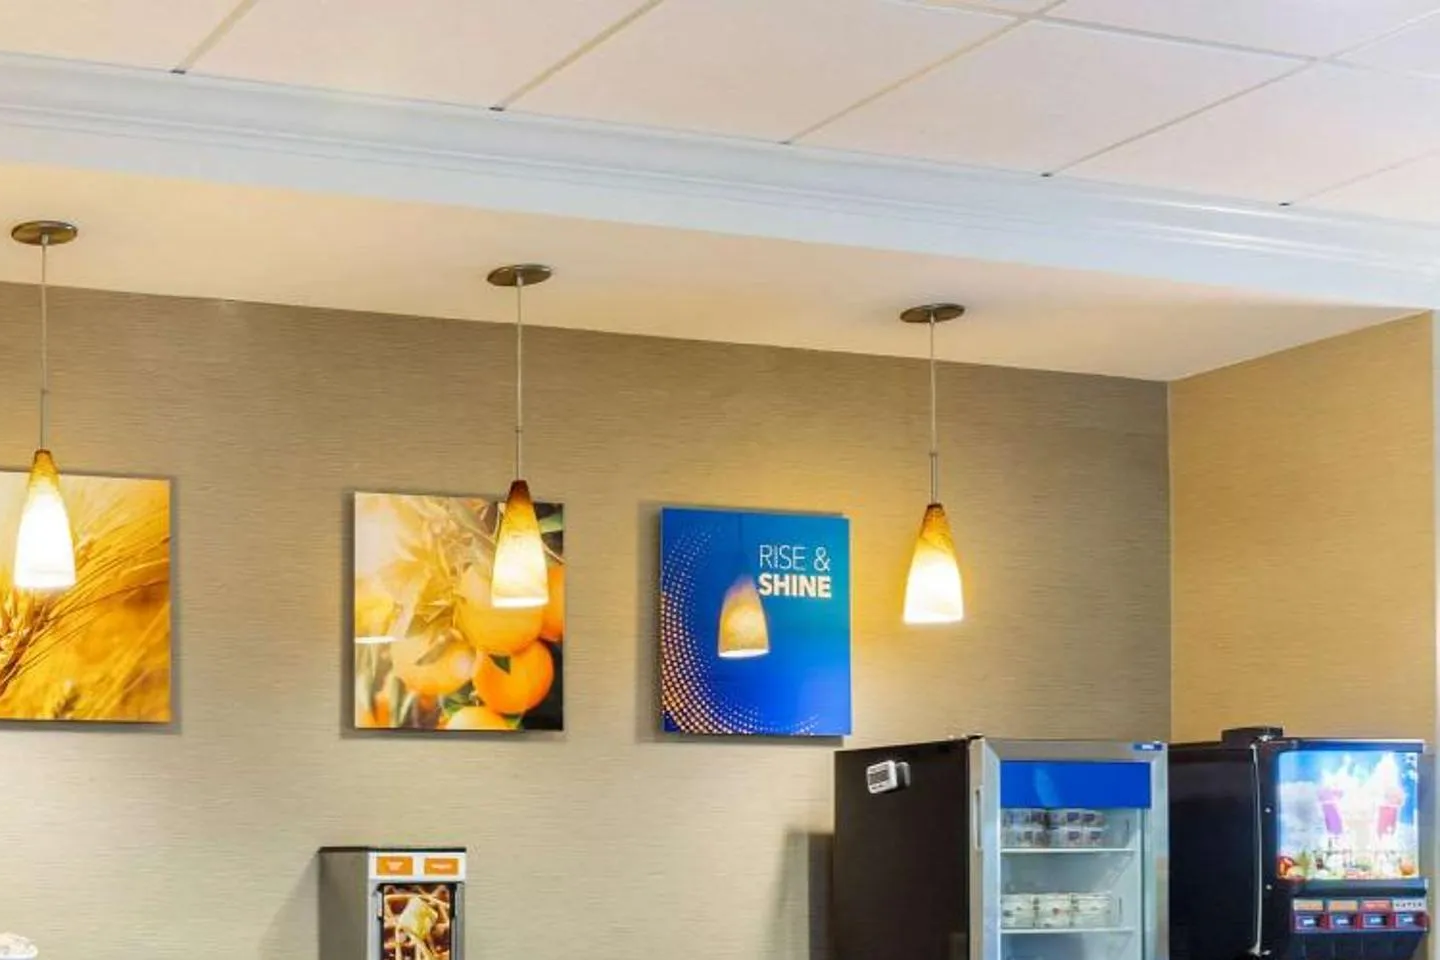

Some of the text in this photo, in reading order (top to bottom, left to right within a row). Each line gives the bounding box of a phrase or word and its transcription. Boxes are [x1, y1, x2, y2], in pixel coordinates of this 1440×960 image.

[759, 544, 831, 572] RISE &
[758, 572, 832, 598] SHINE
